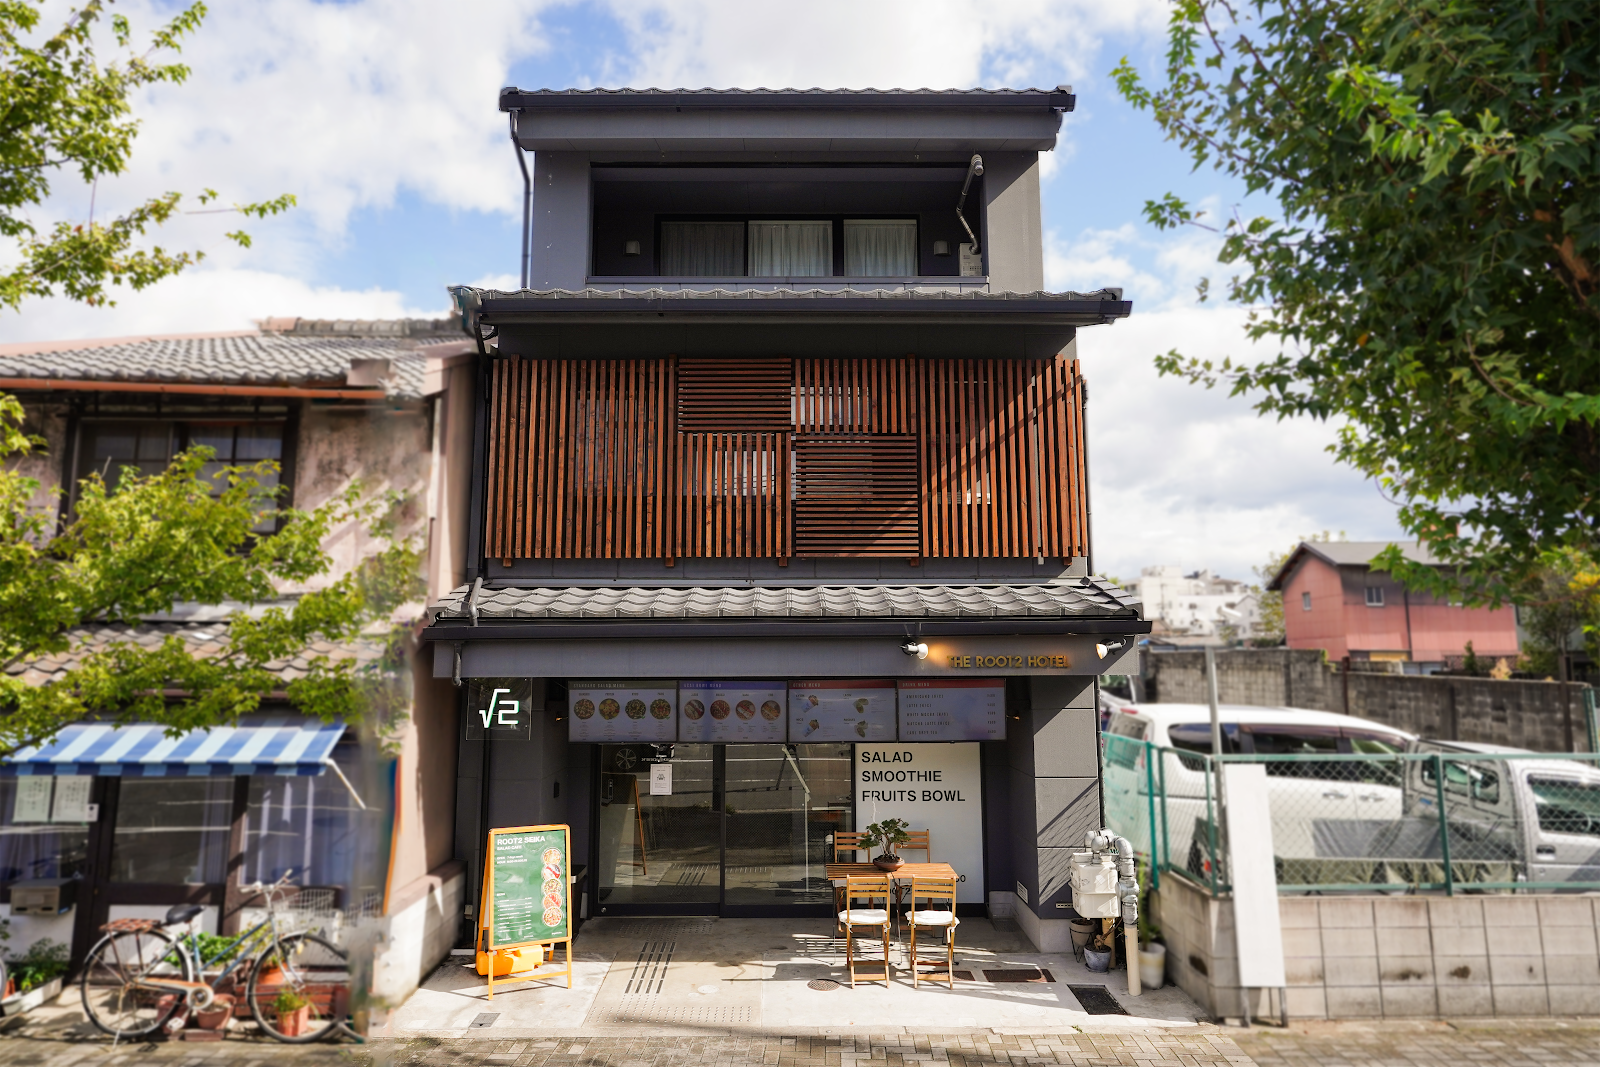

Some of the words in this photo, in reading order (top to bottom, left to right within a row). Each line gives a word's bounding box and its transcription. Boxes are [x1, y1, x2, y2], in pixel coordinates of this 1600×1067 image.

[947, 655, 971, 668] THE
[976, 655, 1023, 668] ROOT2
[1027, 655, 1071, 668] HOTEL
[861, 751, 913, 763] SALAD
[861, 770, 942, 782] SMOOTHIE
[862, 790, 917, 802] FRUITS
[922, 790, 966, 802] BOWL
